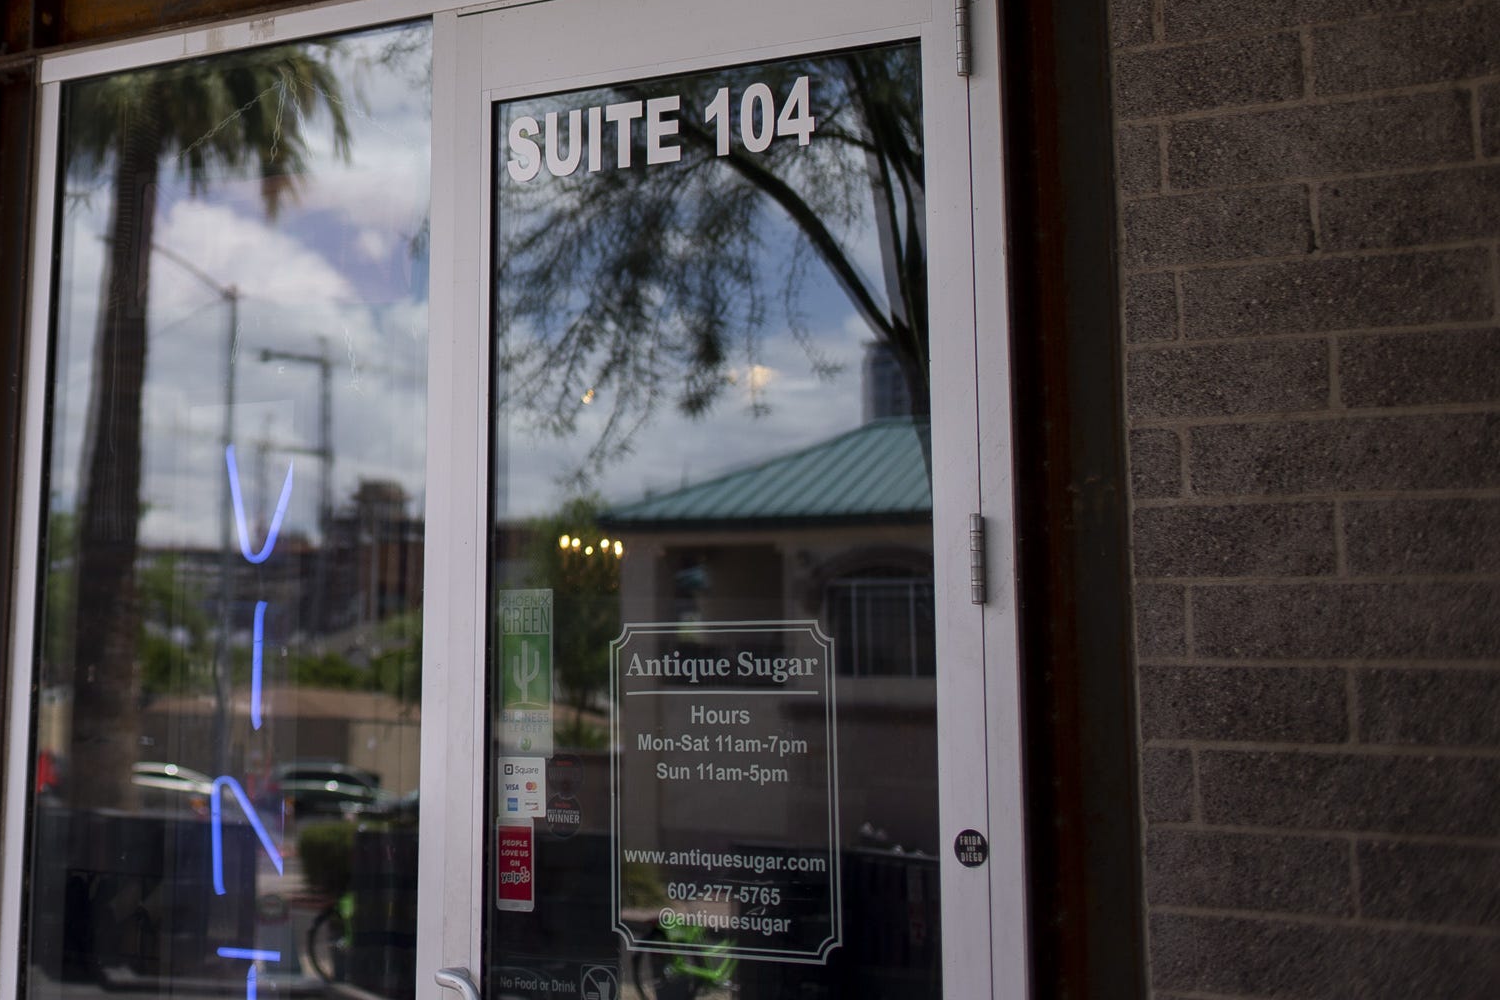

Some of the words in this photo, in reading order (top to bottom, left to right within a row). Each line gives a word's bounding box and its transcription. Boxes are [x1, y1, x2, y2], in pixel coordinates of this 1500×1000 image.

[506, 95, 682, 183] SUITE
[704, 75, 816, 157] 104
[502, 607, 550, 633] GREEN
[625, 651, 731, 683] Antique
[736, 651, 819, 683] Sugar
[690, 705, 751, 724] Hours
[637, 734, 710, 752] Mon-Sat
[715, 735, 808, 757] 11am-7pm
[514, 764, 539, 776] Square
[656, 762, 690, 780] Sun
[696, 762, 788, 786] 11am-5pm
[505, 783, 520, 791] VISA
[547, 813, 580, 825] WINNER
[502, 839, 528, 848] PEOPLE
[960, 835, 982, 846] FRIDA
[501, 849, 519, 857] LOVE
[519, 850, 529, 858] US
[624, 849, 826, 873] www.antiquesugar.com
[960, 852, 983, 862] DIEGO
[501, 871, 521, 885] yelp
[667, 882, 781, 906] 602-277-5765
[658, 907, 792, 936] @antiquesugar
[500, 976, 512, 988] No
[514, 977, 537, 990] Food
[540, 981, 549, 991] or
[551, 980, 577, 993] Drink
